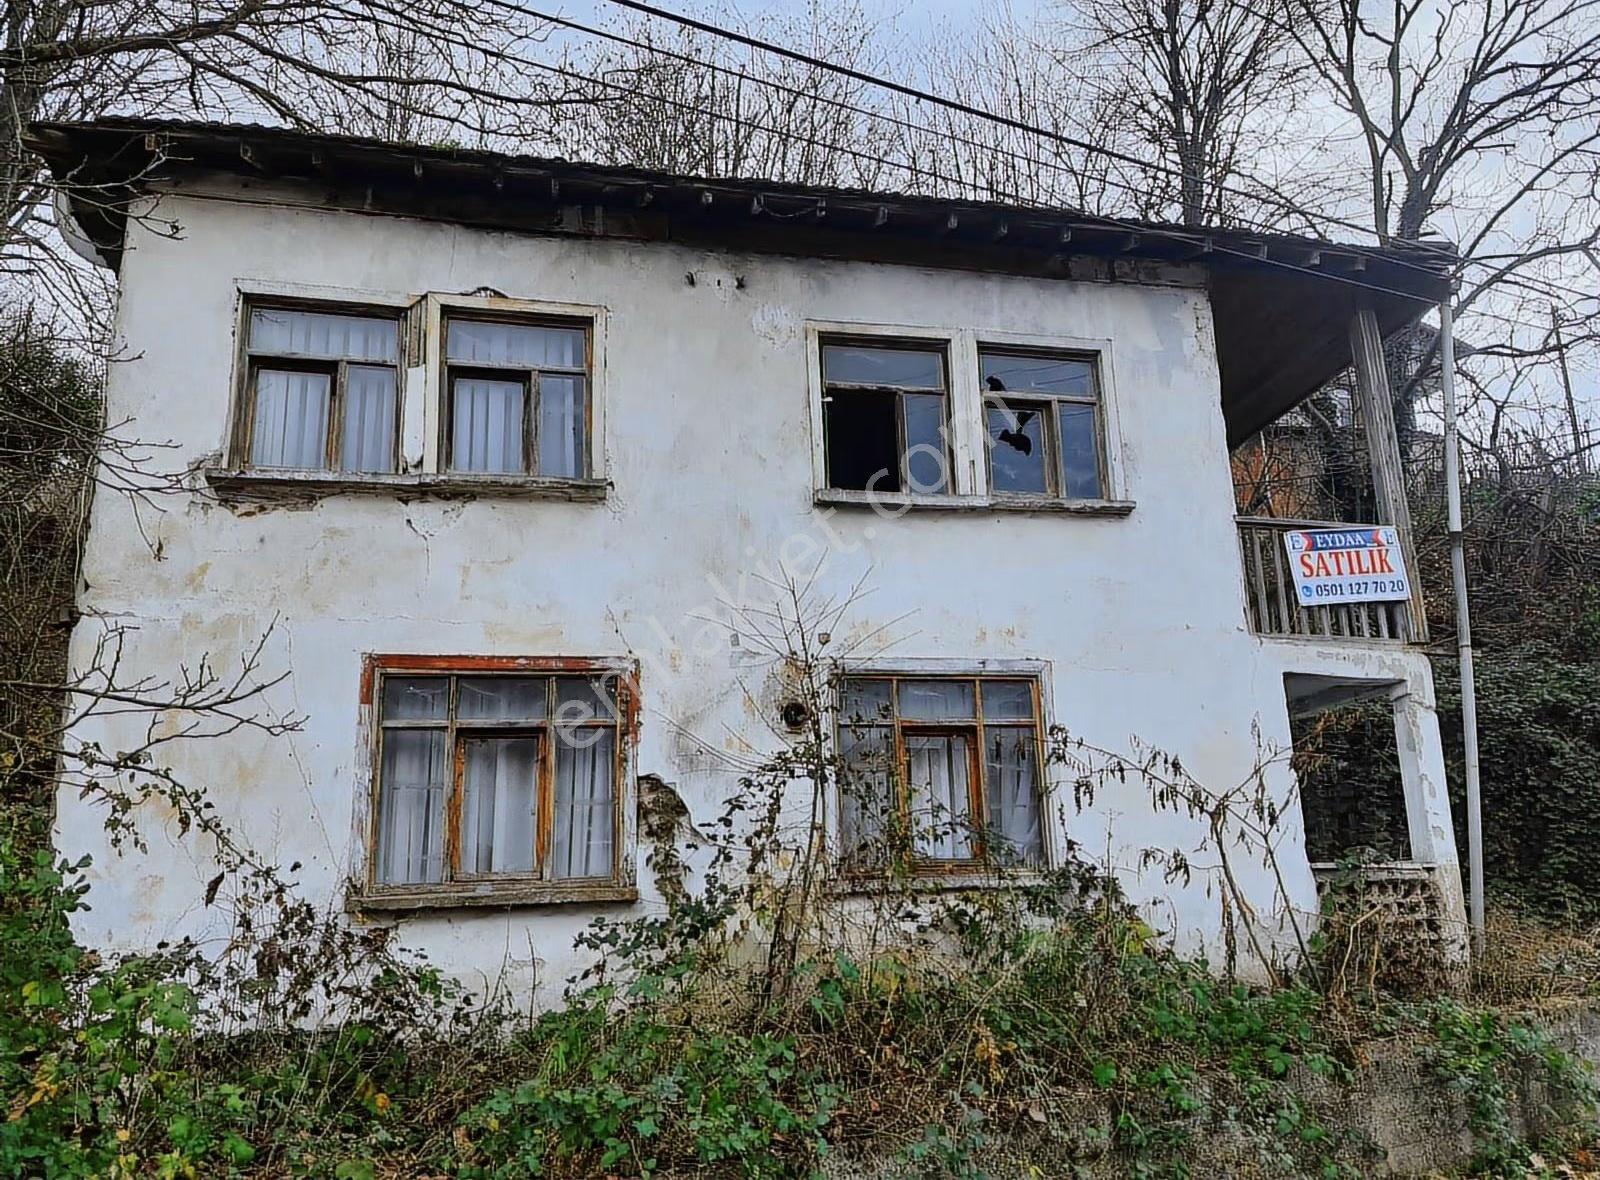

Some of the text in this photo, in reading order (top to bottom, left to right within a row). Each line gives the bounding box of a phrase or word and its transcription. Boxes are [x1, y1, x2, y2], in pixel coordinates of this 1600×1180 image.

[1299, 548, 1395, 578] SATILIK
[1315, 579, 1405, 597] 0501 127 70 20
